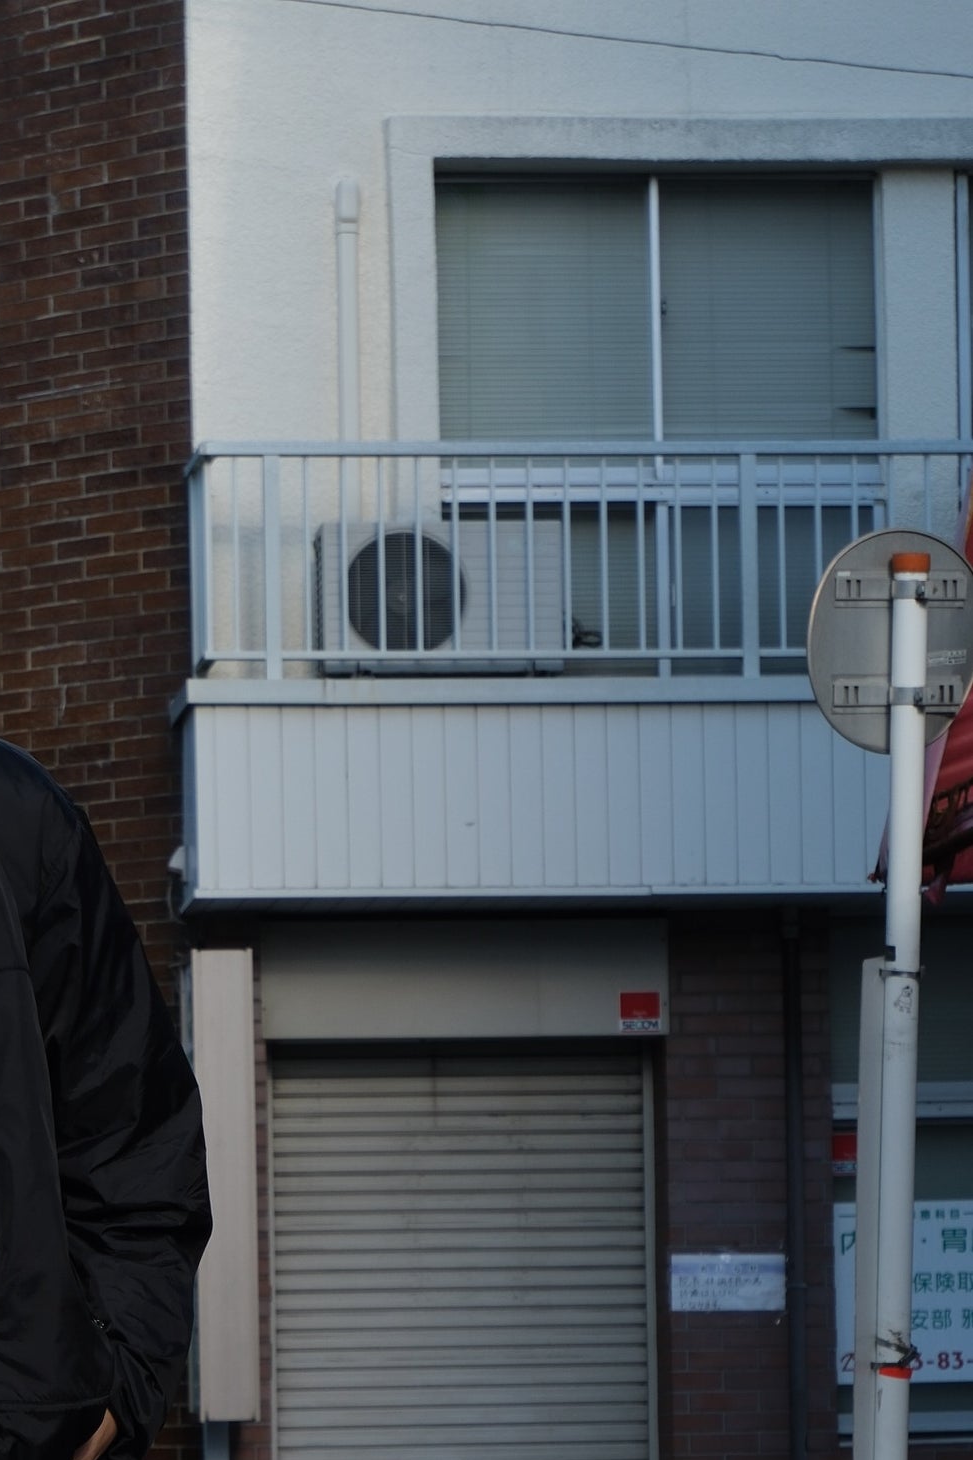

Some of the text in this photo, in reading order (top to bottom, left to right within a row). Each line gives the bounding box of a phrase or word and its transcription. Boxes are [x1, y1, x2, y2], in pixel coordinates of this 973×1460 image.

[622, 1020, 659, 1030] SECOM
[834, 1164, 857, 1172] SEC
[912, 1308, 952, 1330] 安部
